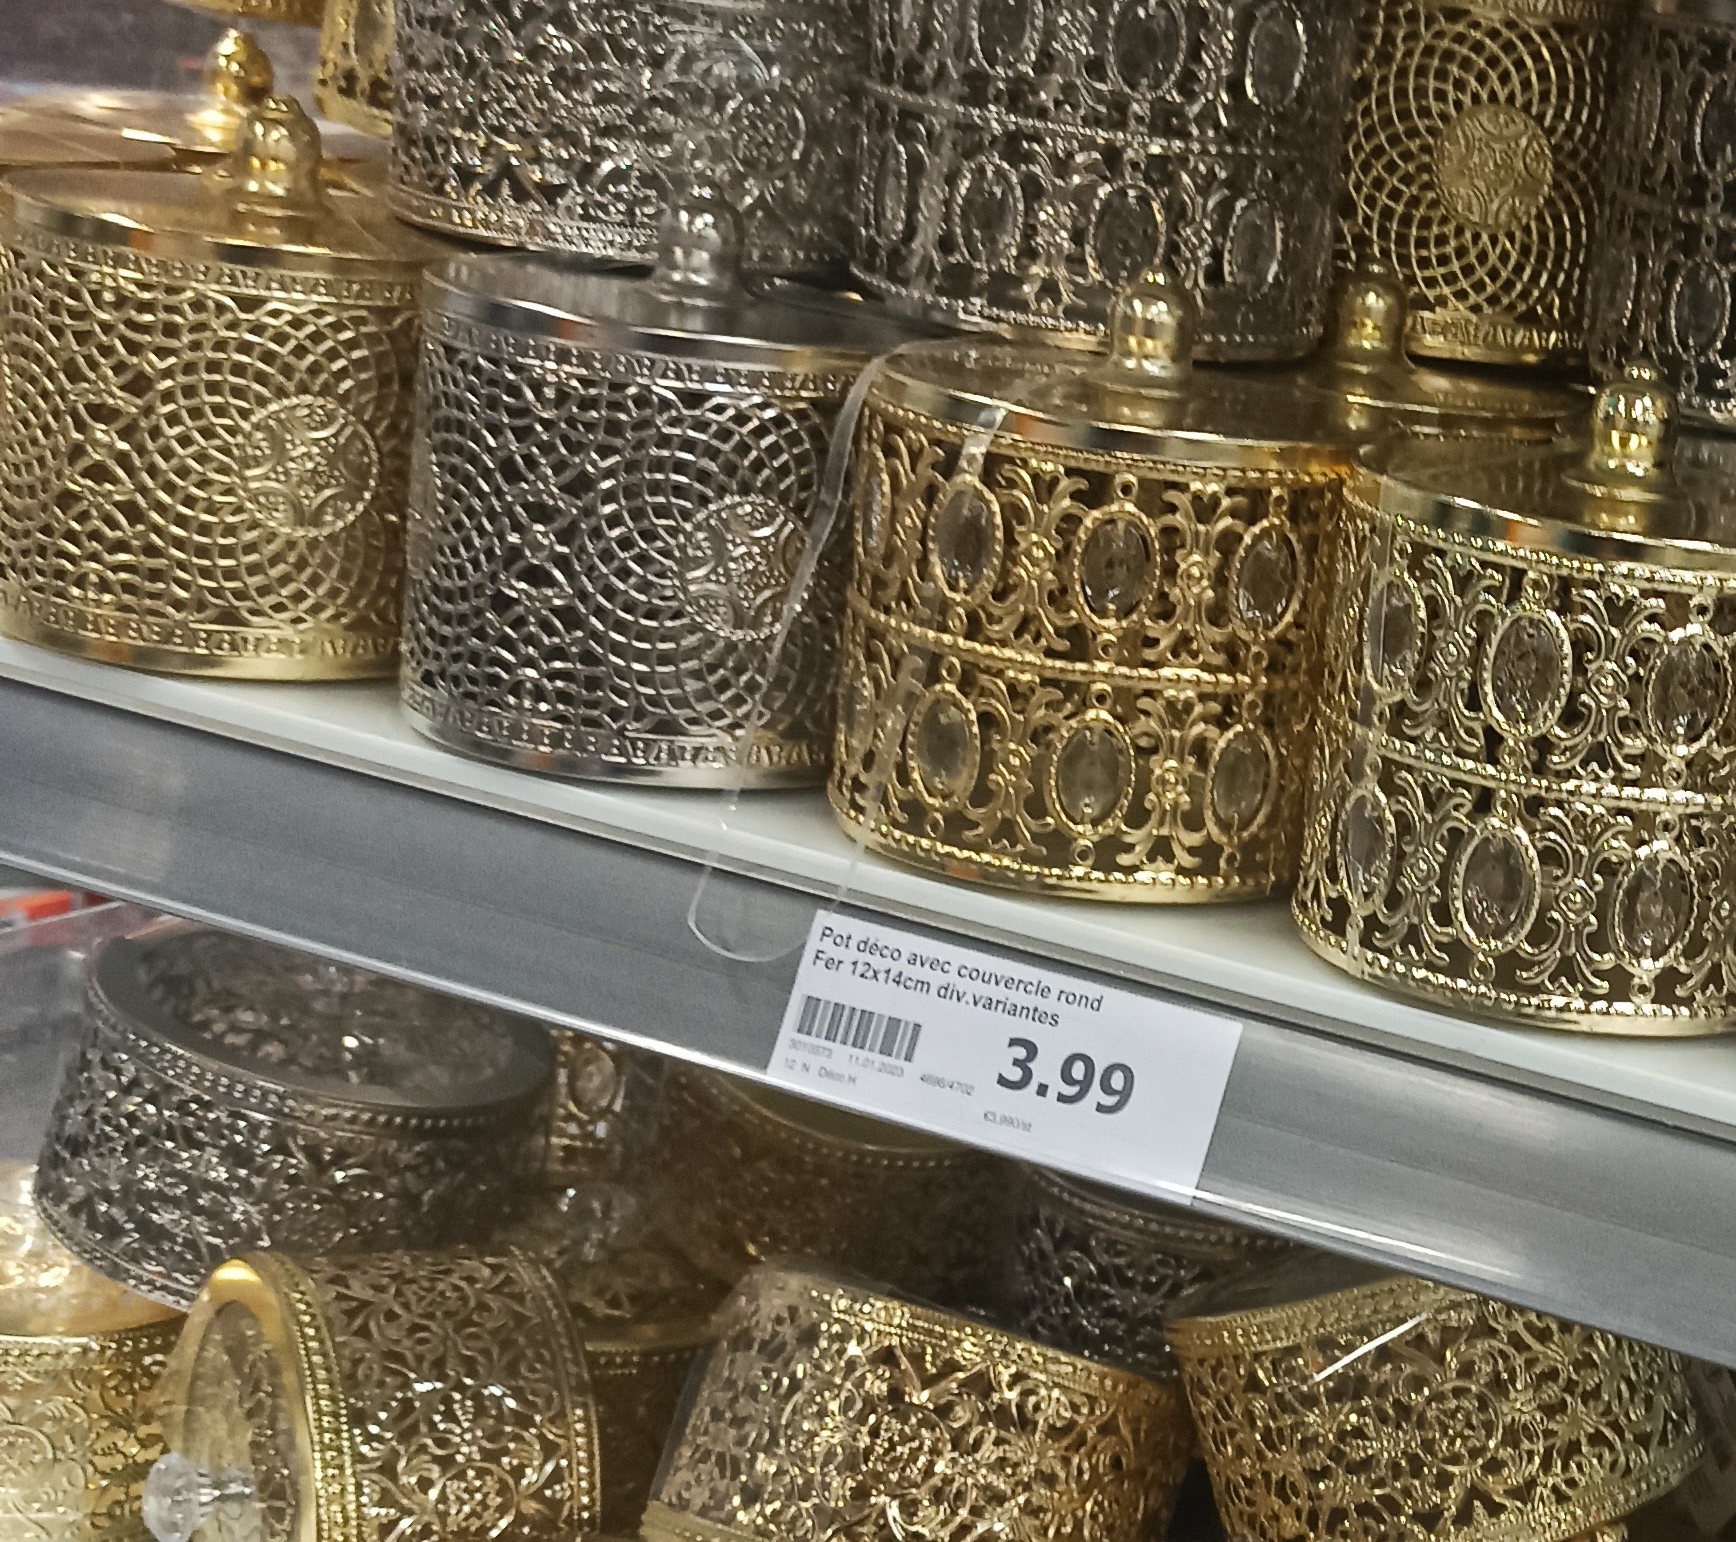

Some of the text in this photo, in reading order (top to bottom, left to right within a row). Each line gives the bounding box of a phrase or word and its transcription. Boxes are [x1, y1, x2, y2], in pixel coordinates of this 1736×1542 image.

[812, 949, 1060, 1028] Fer 12x14cm div.variantes
[819, 926, 1103, 1013] Pot déco avec couvercle rond
[996, 1037, 1135, 1115] 3.99
